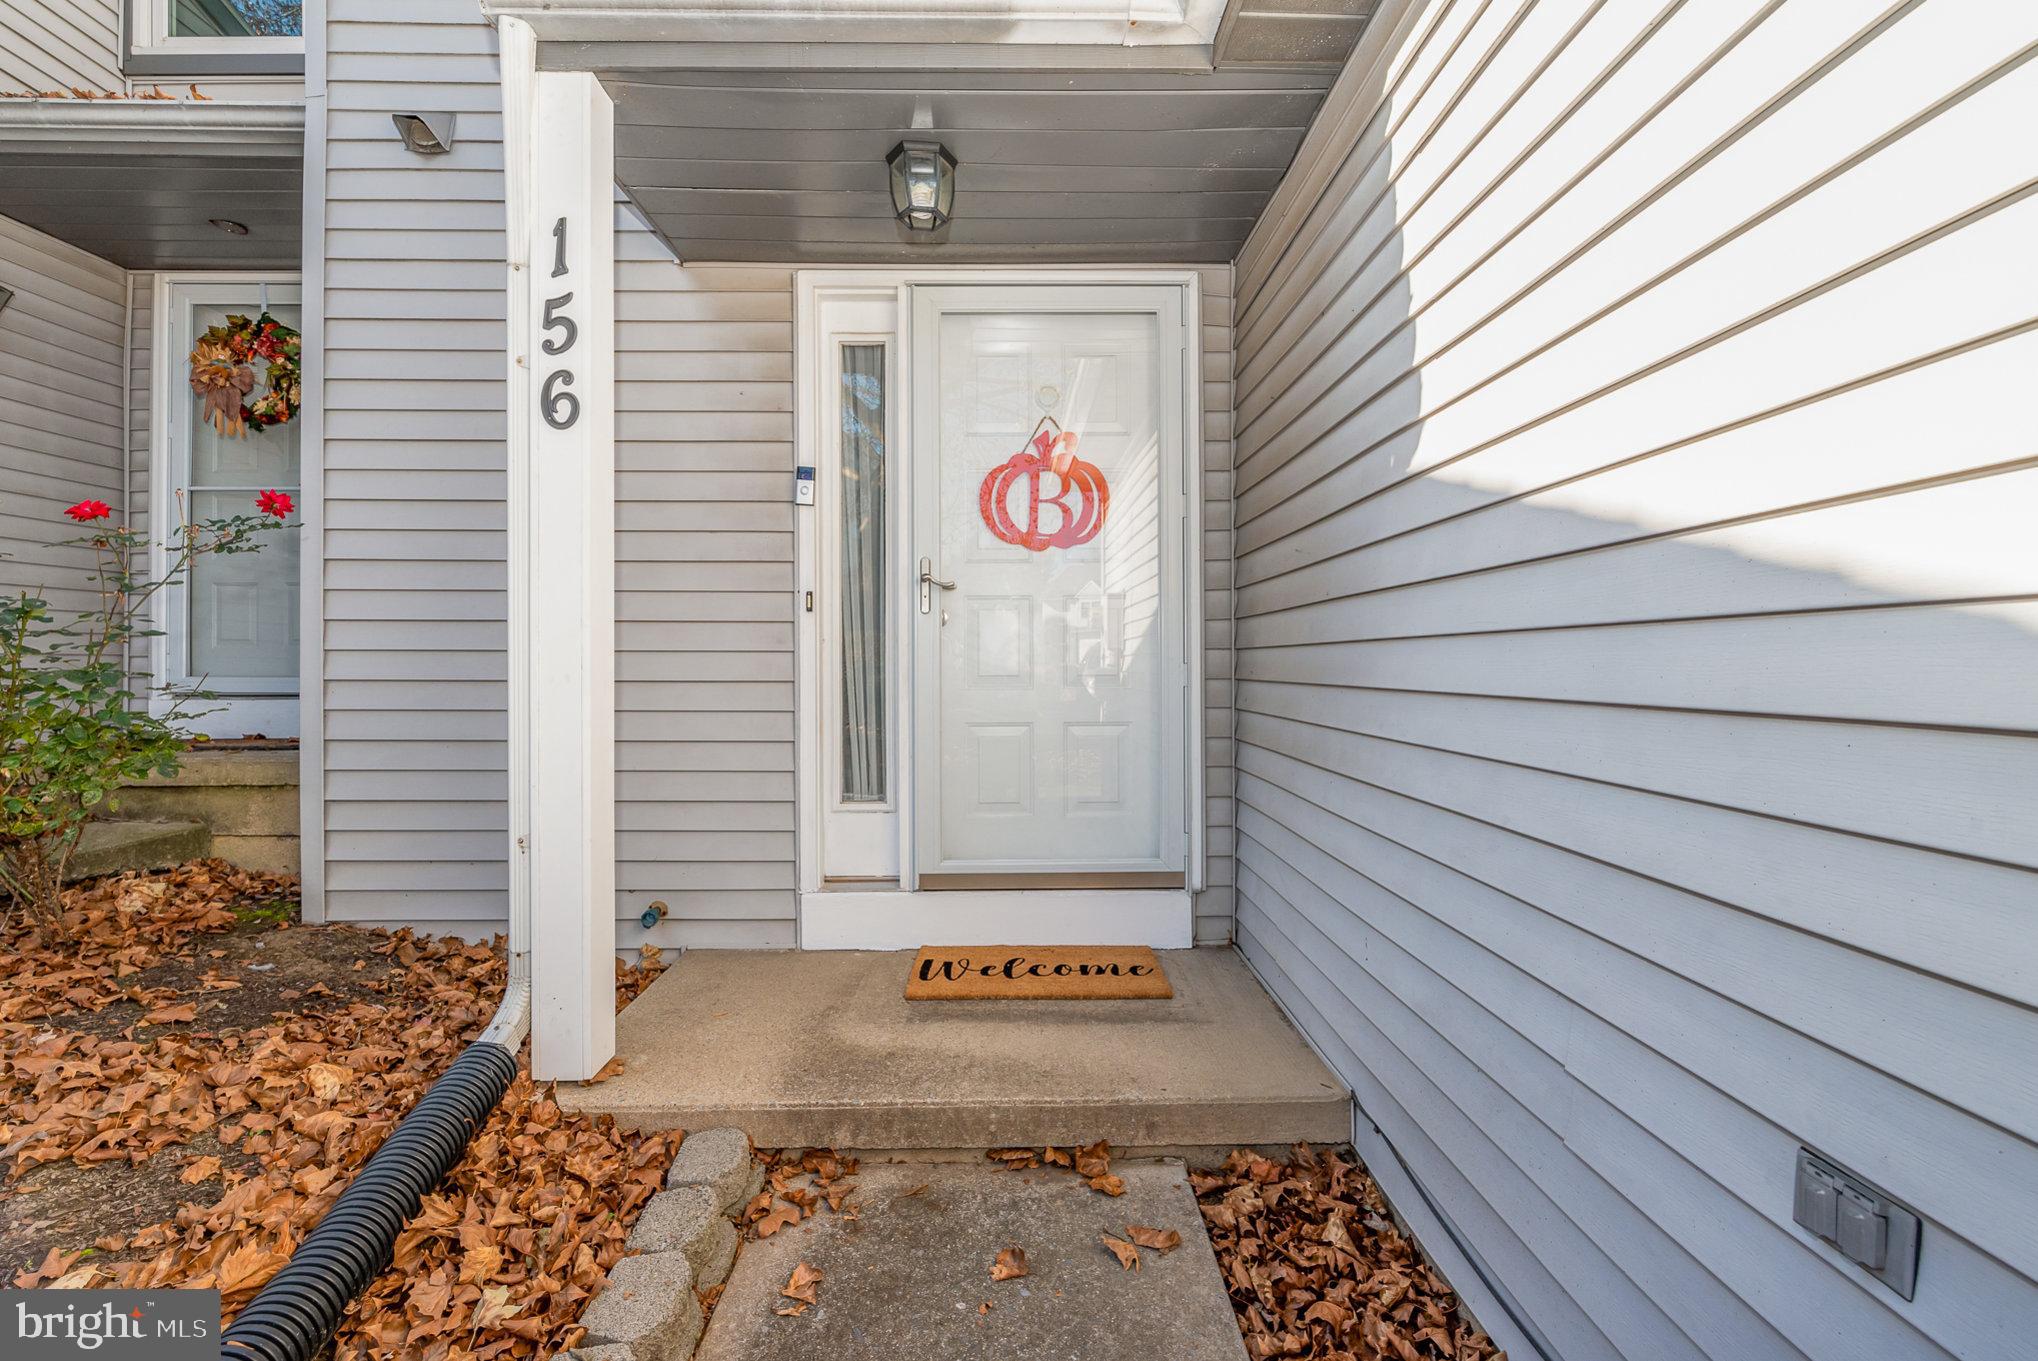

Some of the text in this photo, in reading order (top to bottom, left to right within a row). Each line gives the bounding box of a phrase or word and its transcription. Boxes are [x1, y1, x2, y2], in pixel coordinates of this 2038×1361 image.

[541, 216, 581, 430] 156
[1024, 465, 1075, 539] B
[918, 957, 1154, 981] Welcome
